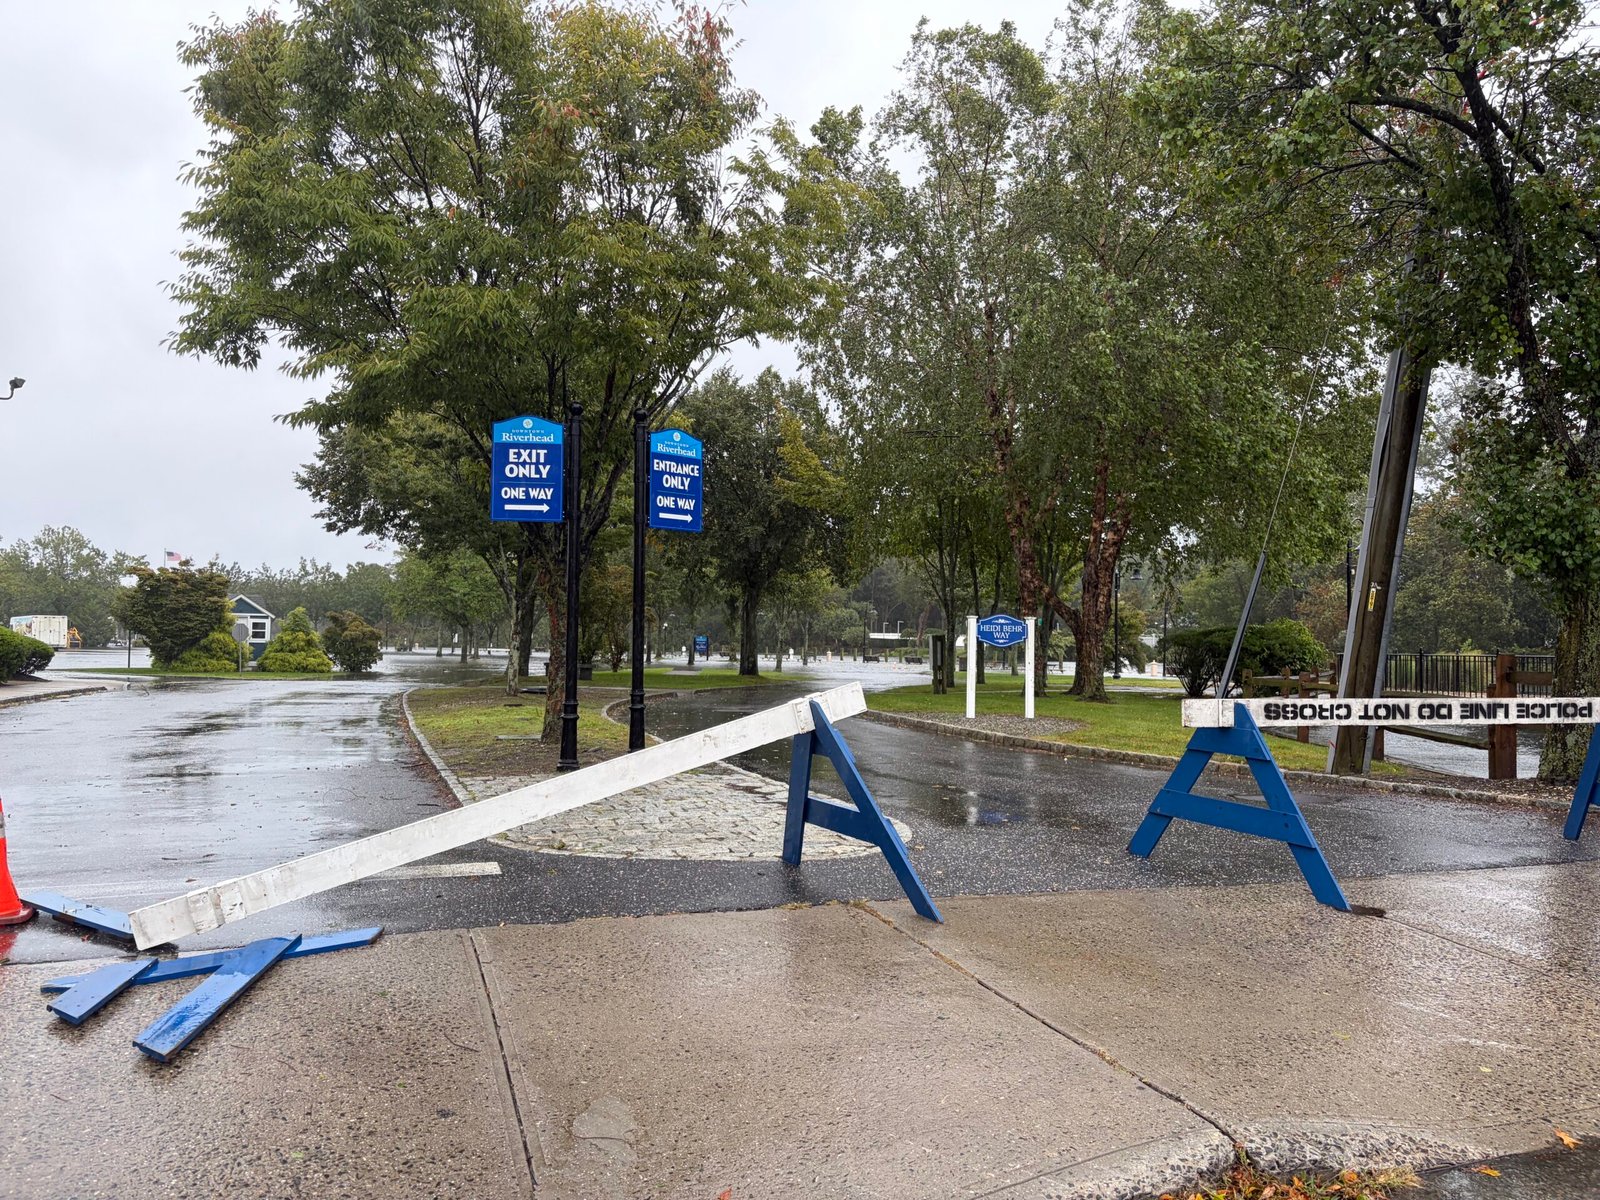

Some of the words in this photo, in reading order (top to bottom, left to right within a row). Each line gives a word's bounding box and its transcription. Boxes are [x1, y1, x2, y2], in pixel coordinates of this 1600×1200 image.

[502, 433, 554, 442] Riverhead
[509, 448, 548, 463] EXIT
[657, 443, 696, 457] Riverhead
[504, 464, 551, 478] ONLY
[653, 459, 700, 477] ENTRANCE
[662, 474, 691, 490] ONLY
[501, 487, 526, 499] ONE
[528, 488, 554, 500] WAY
[656, 495, 676, 508] ONE
[676, 498, 696, 511] WAY
[980, 624, 1001, 632] HEIDI
[1263, 703, 1352, 720] CROSS
[1358, 703, 1410, 720] NOT
[1418, 703, 1453, 720] DO
[1460, 702, 1509, 720] LINE
[1516, 702, 1593, 720] POLICE
